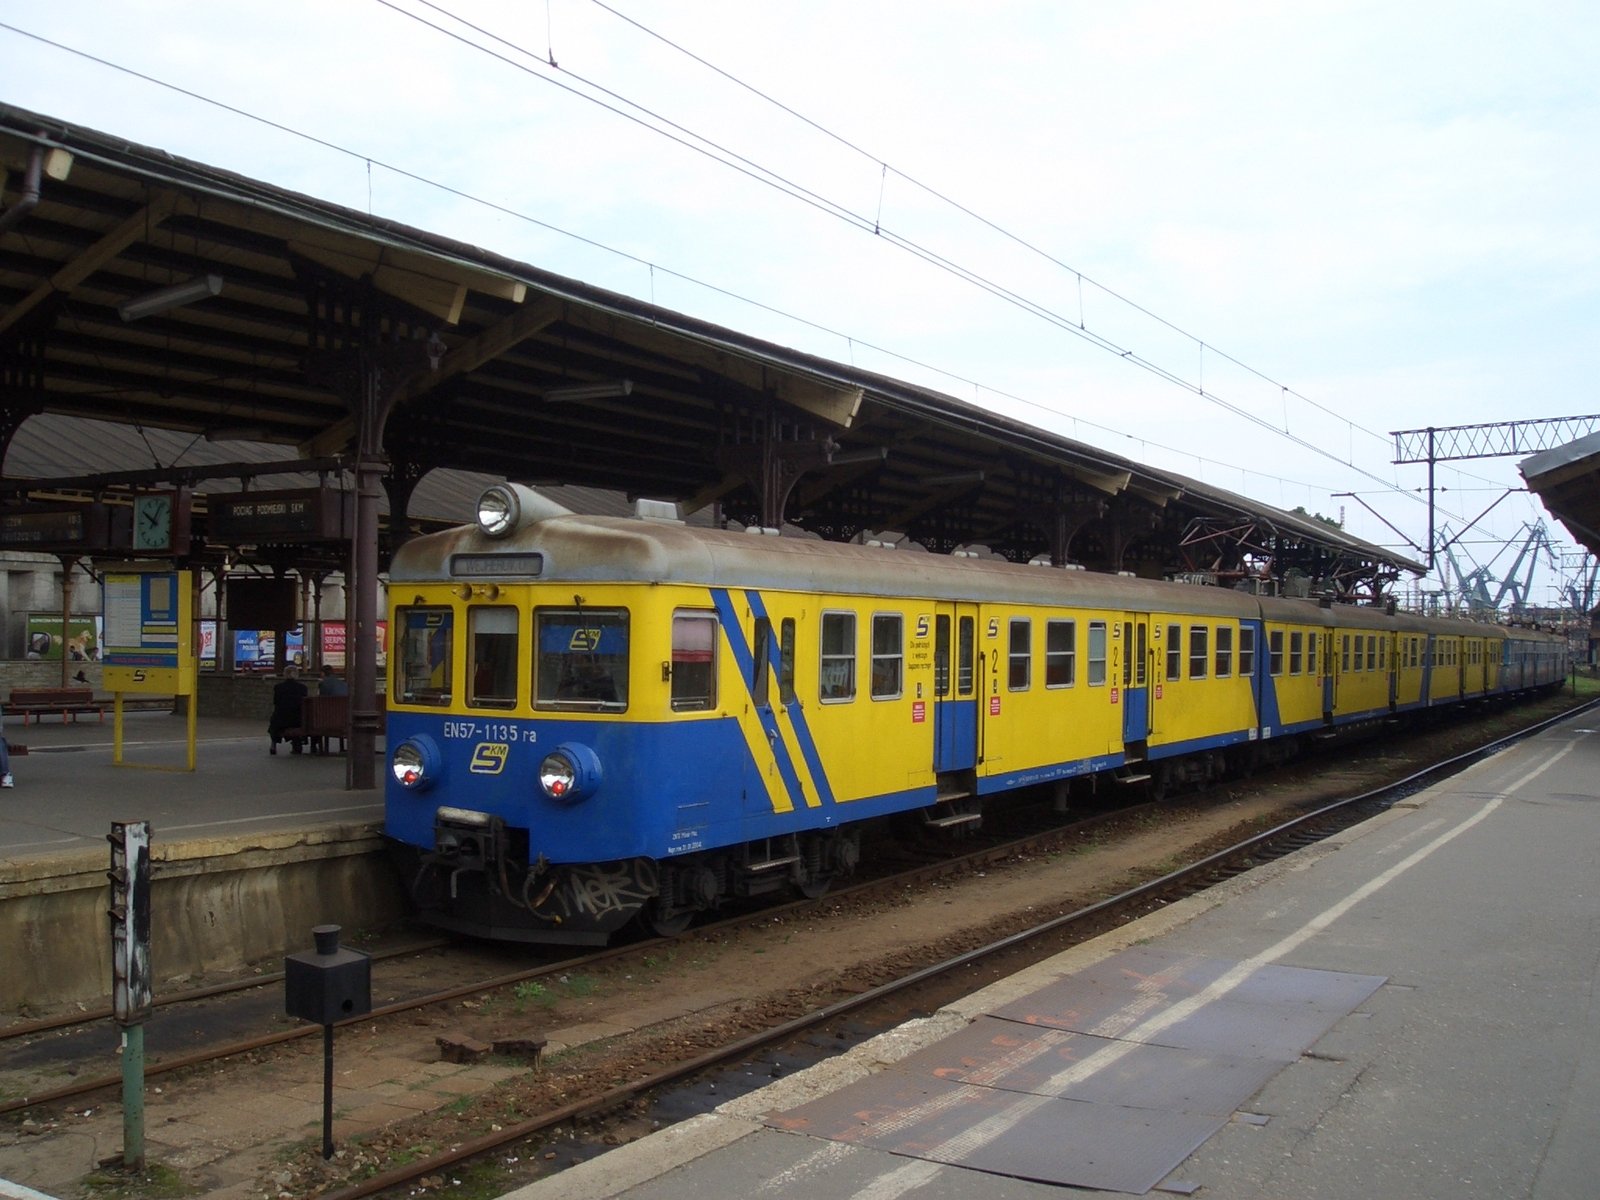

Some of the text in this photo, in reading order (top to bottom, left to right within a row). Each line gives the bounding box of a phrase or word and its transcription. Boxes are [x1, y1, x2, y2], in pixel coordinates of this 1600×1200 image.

[992, 648, 999, 674] 2
[1113, 646, 1118, 667] 2
[443, 721, 537, 743] EN57-1135 ra
[471, 745, 508, 771] SKM
